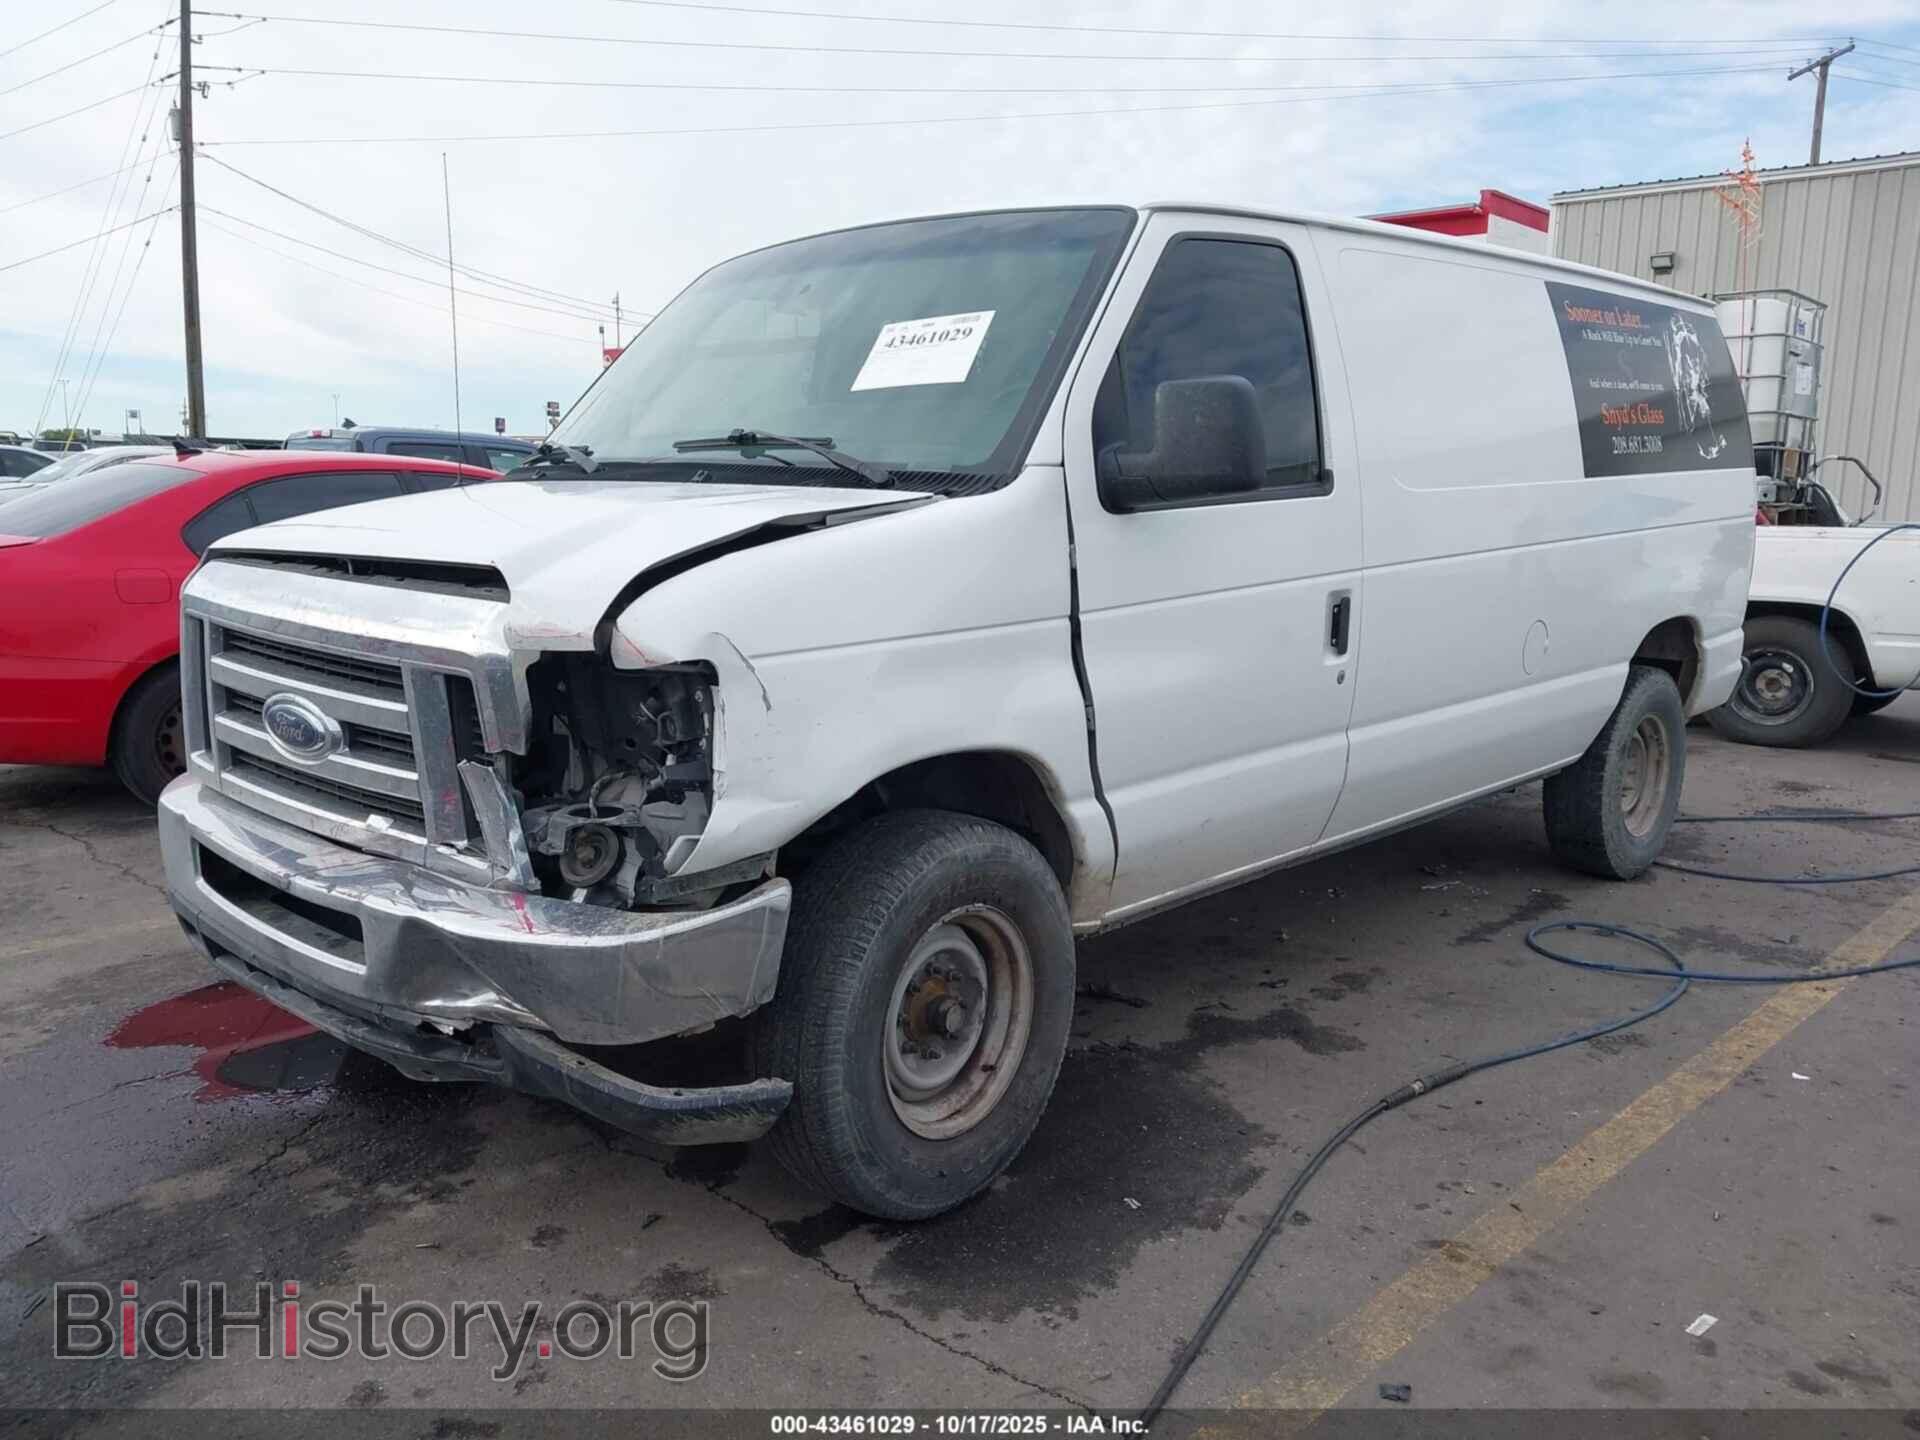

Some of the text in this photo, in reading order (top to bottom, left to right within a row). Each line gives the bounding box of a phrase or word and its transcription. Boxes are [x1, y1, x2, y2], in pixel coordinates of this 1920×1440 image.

[884, 326, 974, 349] 43461029
[1638, 403, 1664, 424] Glass
[272, 711, 305, 742] Ford
